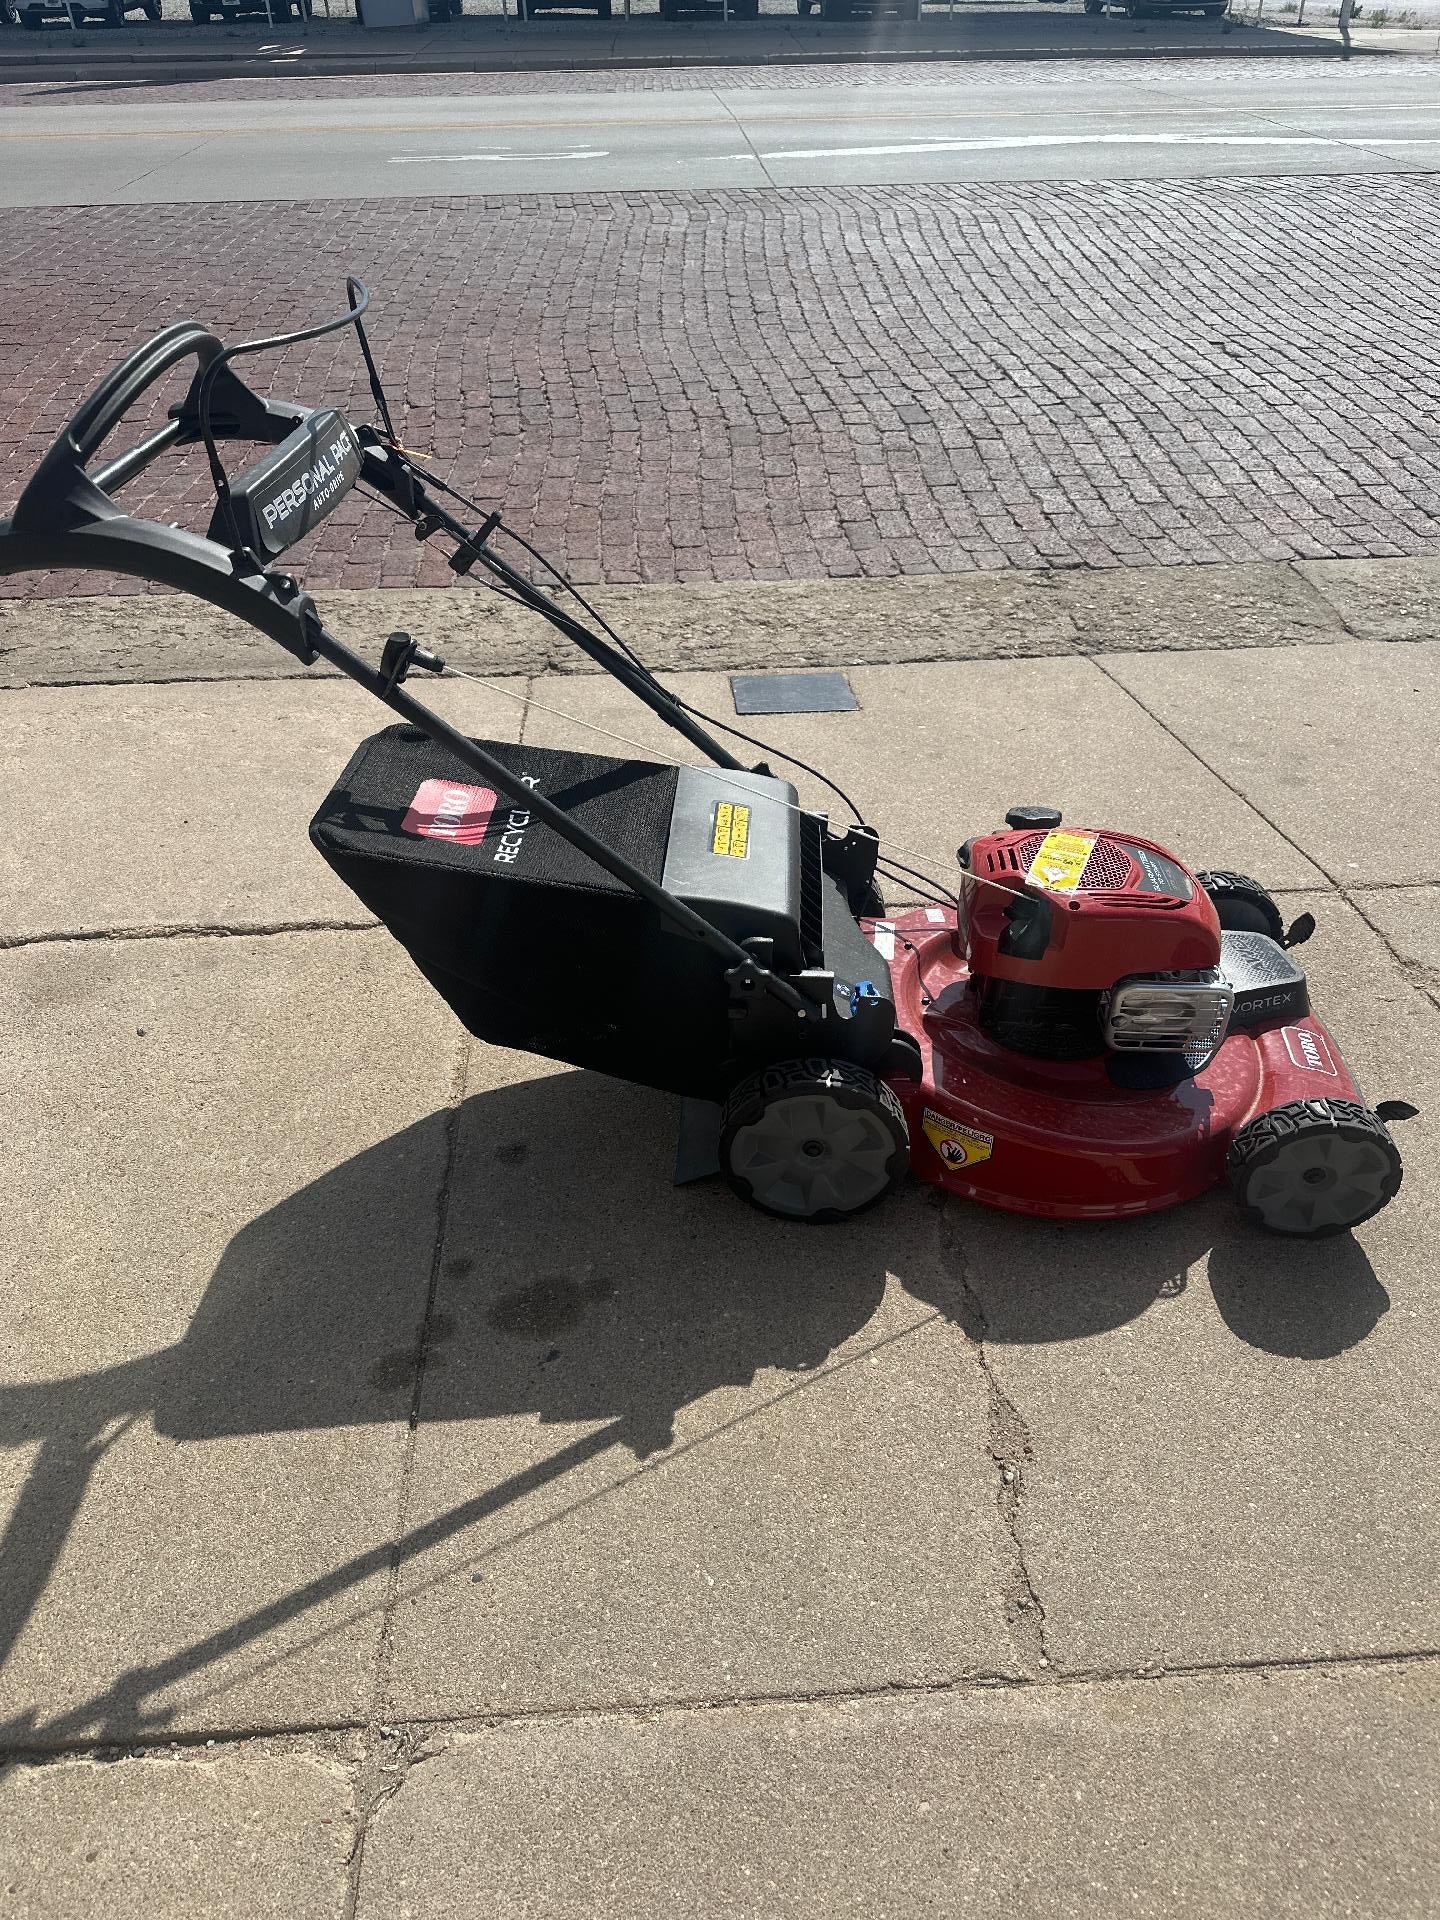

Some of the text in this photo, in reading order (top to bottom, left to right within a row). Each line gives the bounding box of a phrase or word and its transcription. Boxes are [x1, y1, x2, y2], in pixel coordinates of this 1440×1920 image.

[262, 455, 335, 530] PERSONAL
[427, 789, 470, 837] TORO
[494, 775, 540, 864] RECYCLR
[1232, 992, 1292, 1014] VORTEX
[1298, 1032, 1323, 1067] TORO
